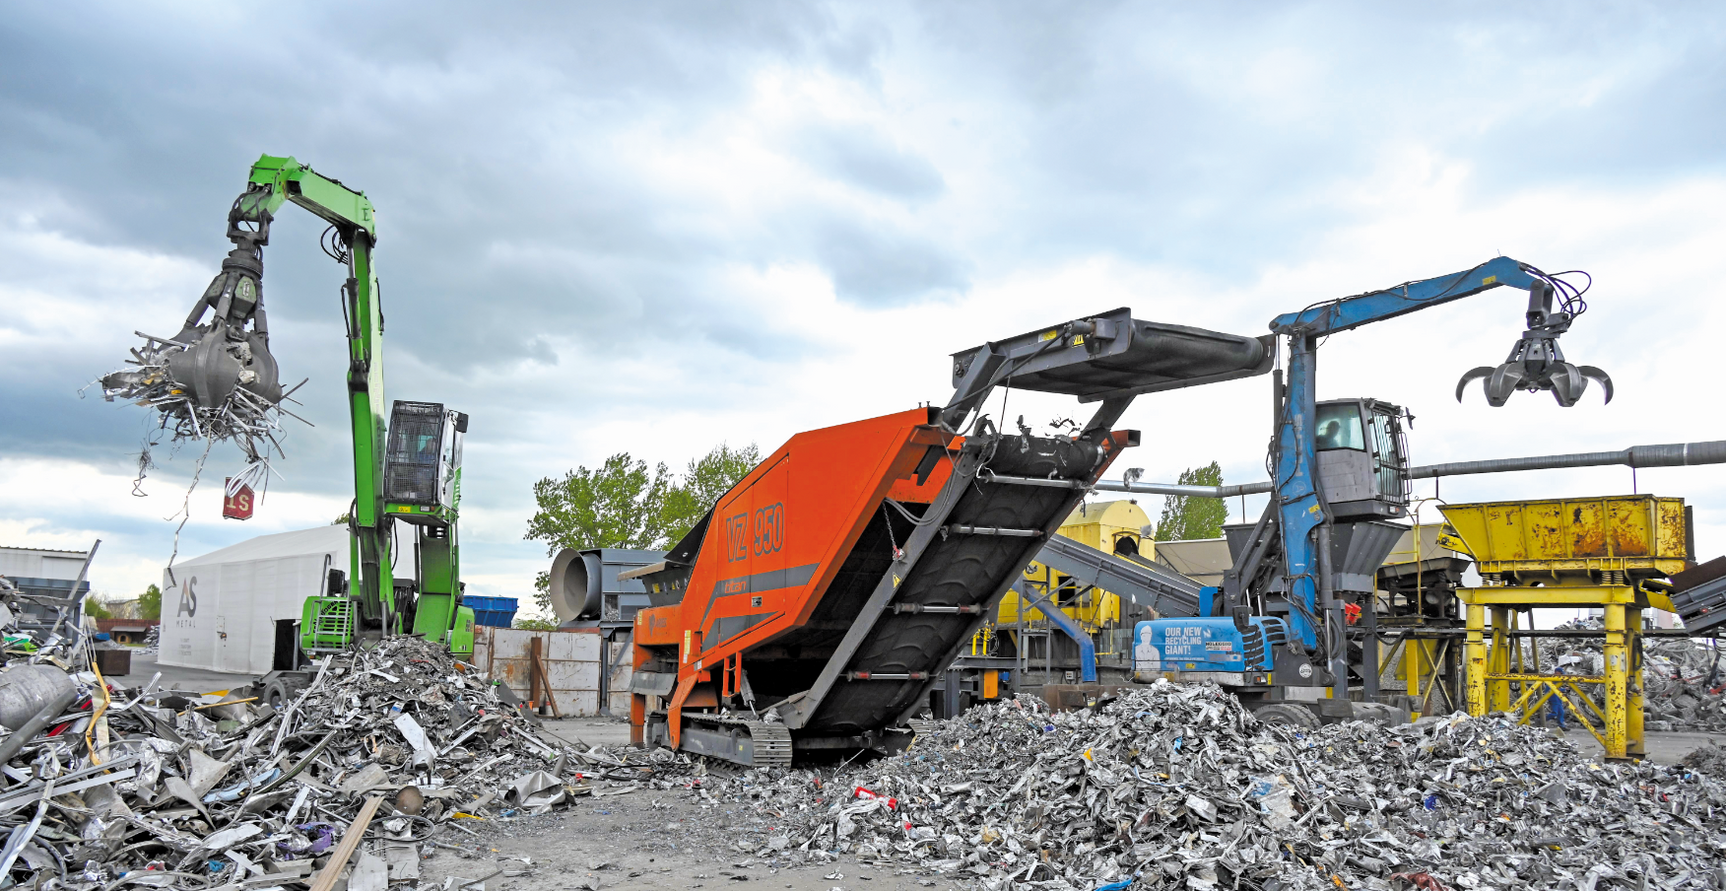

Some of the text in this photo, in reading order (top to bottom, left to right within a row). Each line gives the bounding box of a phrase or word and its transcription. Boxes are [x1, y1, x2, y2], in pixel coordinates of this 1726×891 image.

[726, 502, 785, 563] VZ 950
[724, 581, 747, 594] titan
[177, 576, 197, 617] AS
[176, 619, 196, 628] METAL
[1165, 626, 1202, 637] OUR NEW
[1165, 636, 1202, 645] RECYCLING
[1165, 645, 1191, 655] GIANT!
